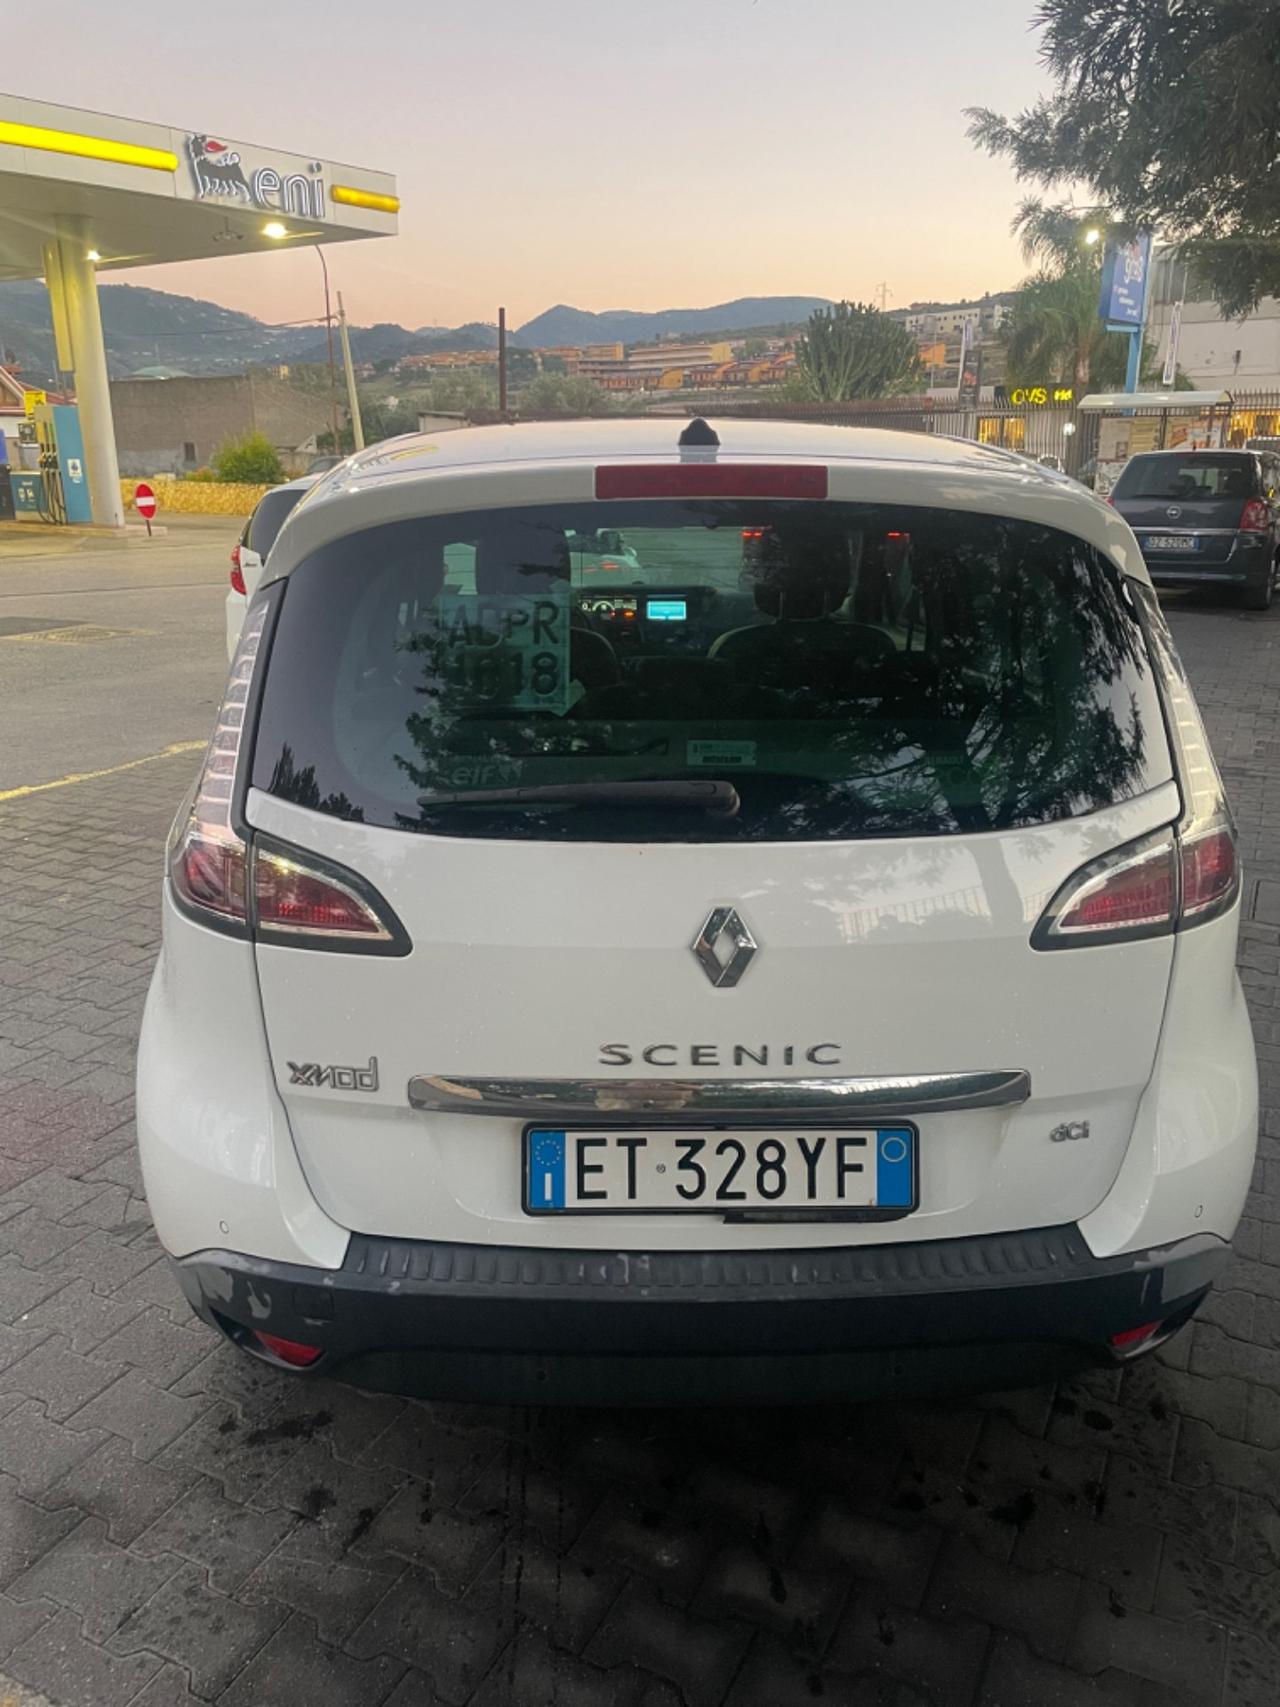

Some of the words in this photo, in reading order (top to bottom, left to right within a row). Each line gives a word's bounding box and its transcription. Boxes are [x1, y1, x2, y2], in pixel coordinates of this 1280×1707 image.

[254, 162, 325, 218] eni
[1011, 387, 1047, 405] OVS
[598, 1044, 841, 1067] SCENIC
[1049, 1119, 1089, 1136] dCi
[576, 1138, 647, 1199] ET
[675, 1138, 867, 1200] 328YF
